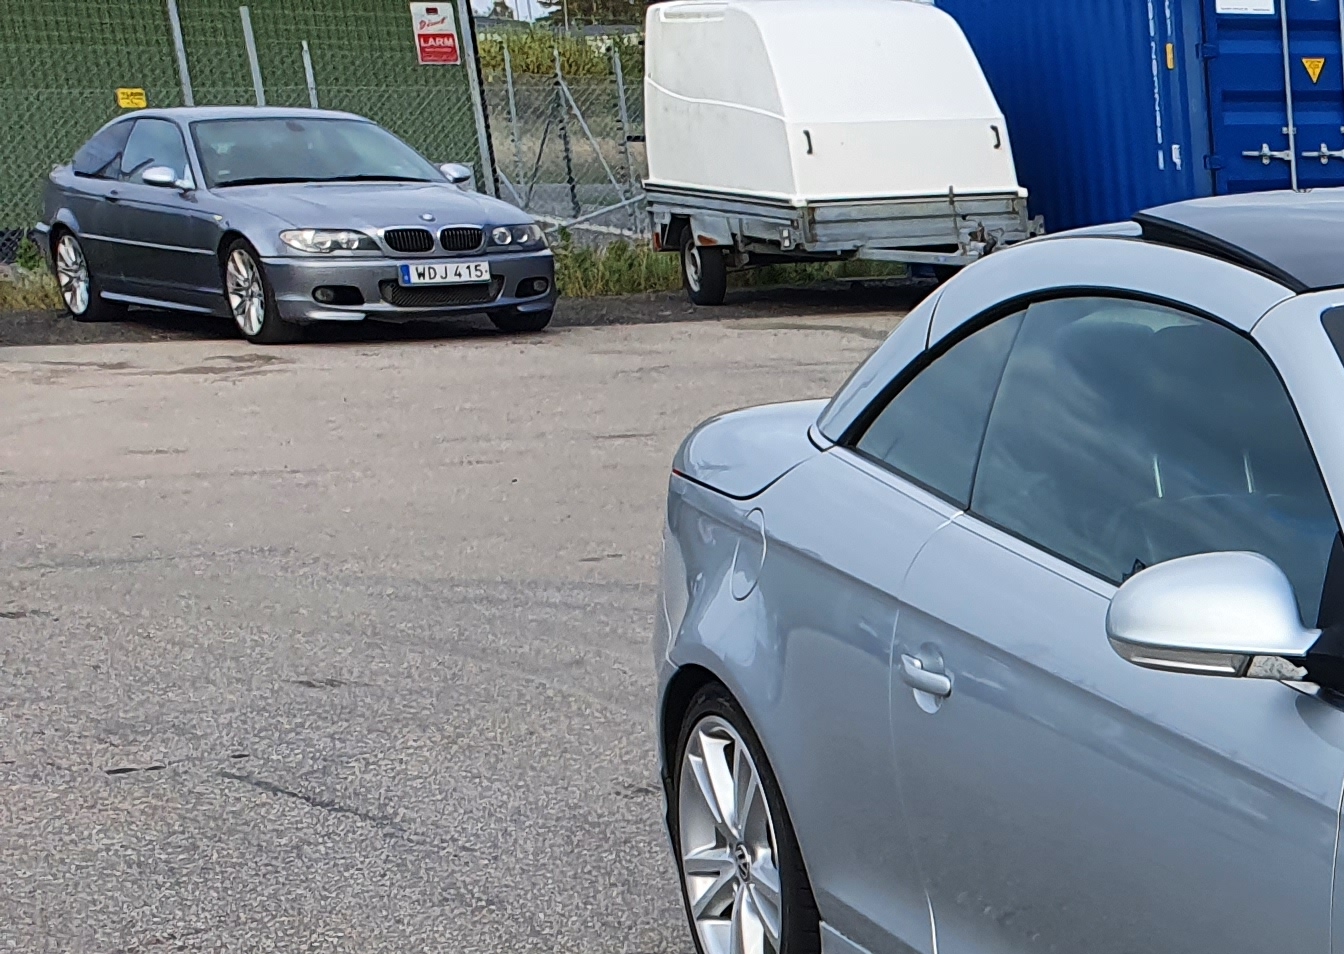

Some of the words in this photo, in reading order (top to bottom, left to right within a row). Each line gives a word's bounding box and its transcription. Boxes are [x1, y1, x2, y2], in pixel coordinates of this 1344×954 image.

[420, 36, 454, 47] LARM
[415, 265, 448, 281] WDJ
[454, 263, 484, 279] 415
